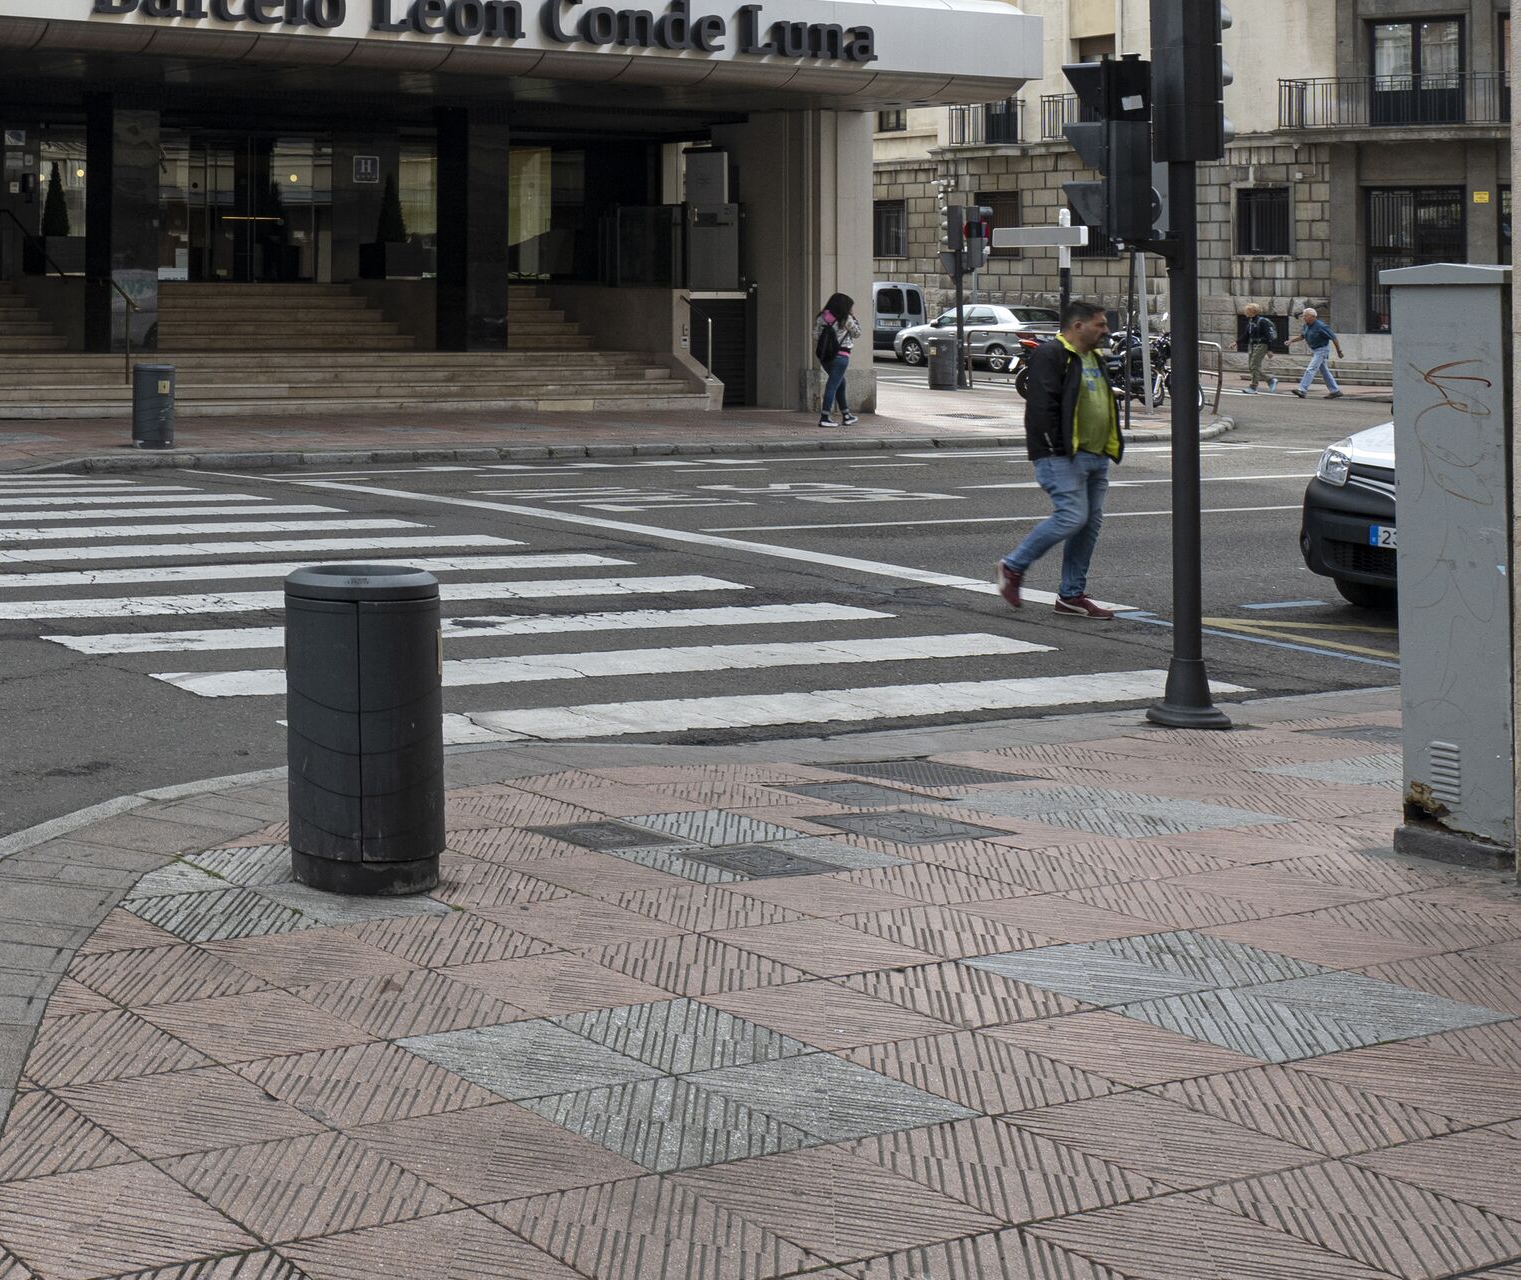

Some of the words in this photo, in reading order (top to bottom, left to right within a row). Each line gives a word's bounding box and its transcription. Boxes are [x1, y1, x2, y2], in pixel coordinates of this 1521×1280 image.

[739, 4, 878, 61] Luna
[360, 159, 372, 173] H
[696, 482, 970, 504] BUS
